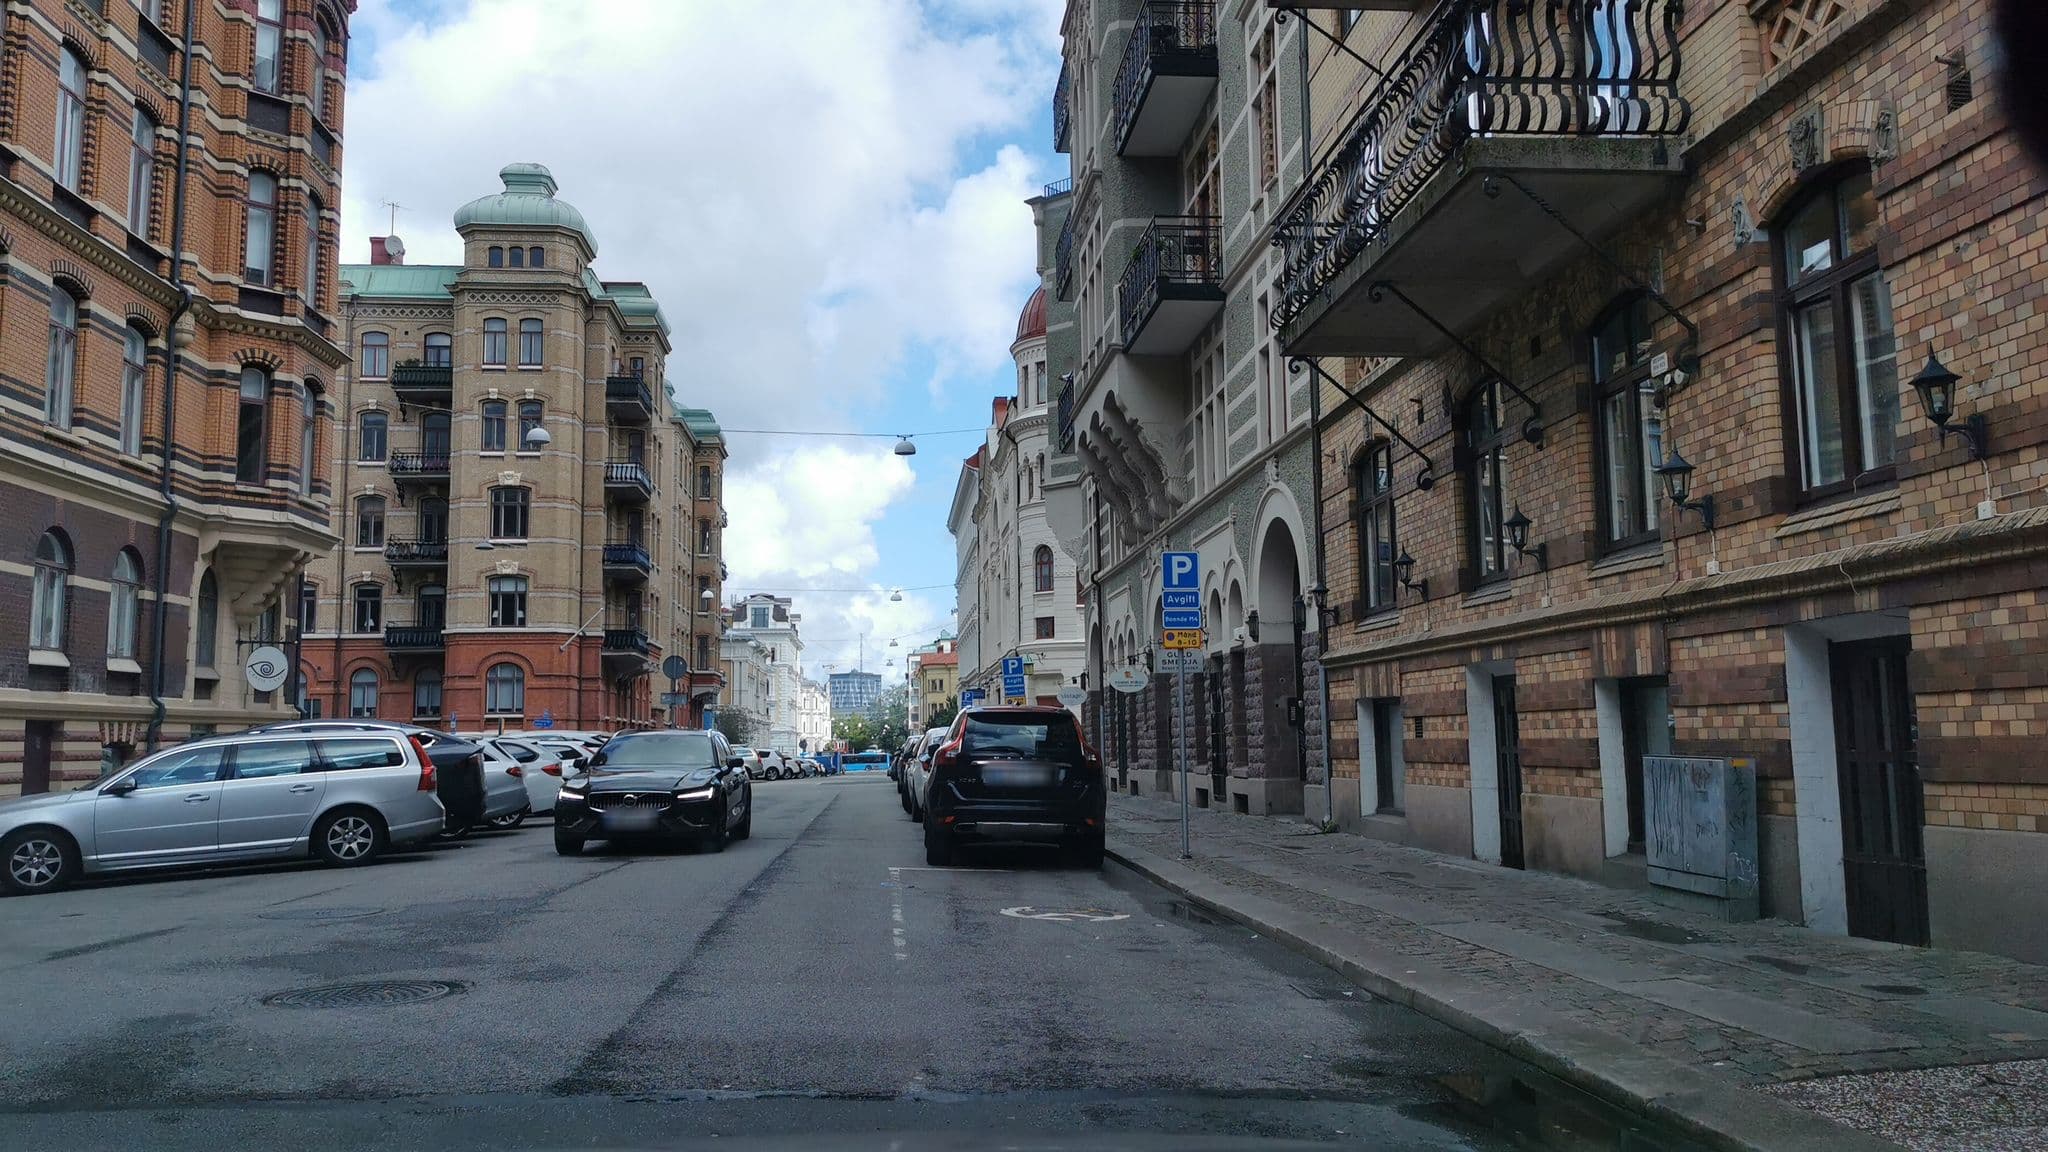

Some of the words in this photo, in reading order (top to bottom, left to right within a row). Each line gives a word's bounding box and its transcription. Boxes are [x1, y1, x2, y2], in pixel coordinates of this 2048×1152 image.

[1171, 555, 1192, 585] P
[1167, 594, 1195, 605] Avgift
[1008, 659, 1019, 674] P
